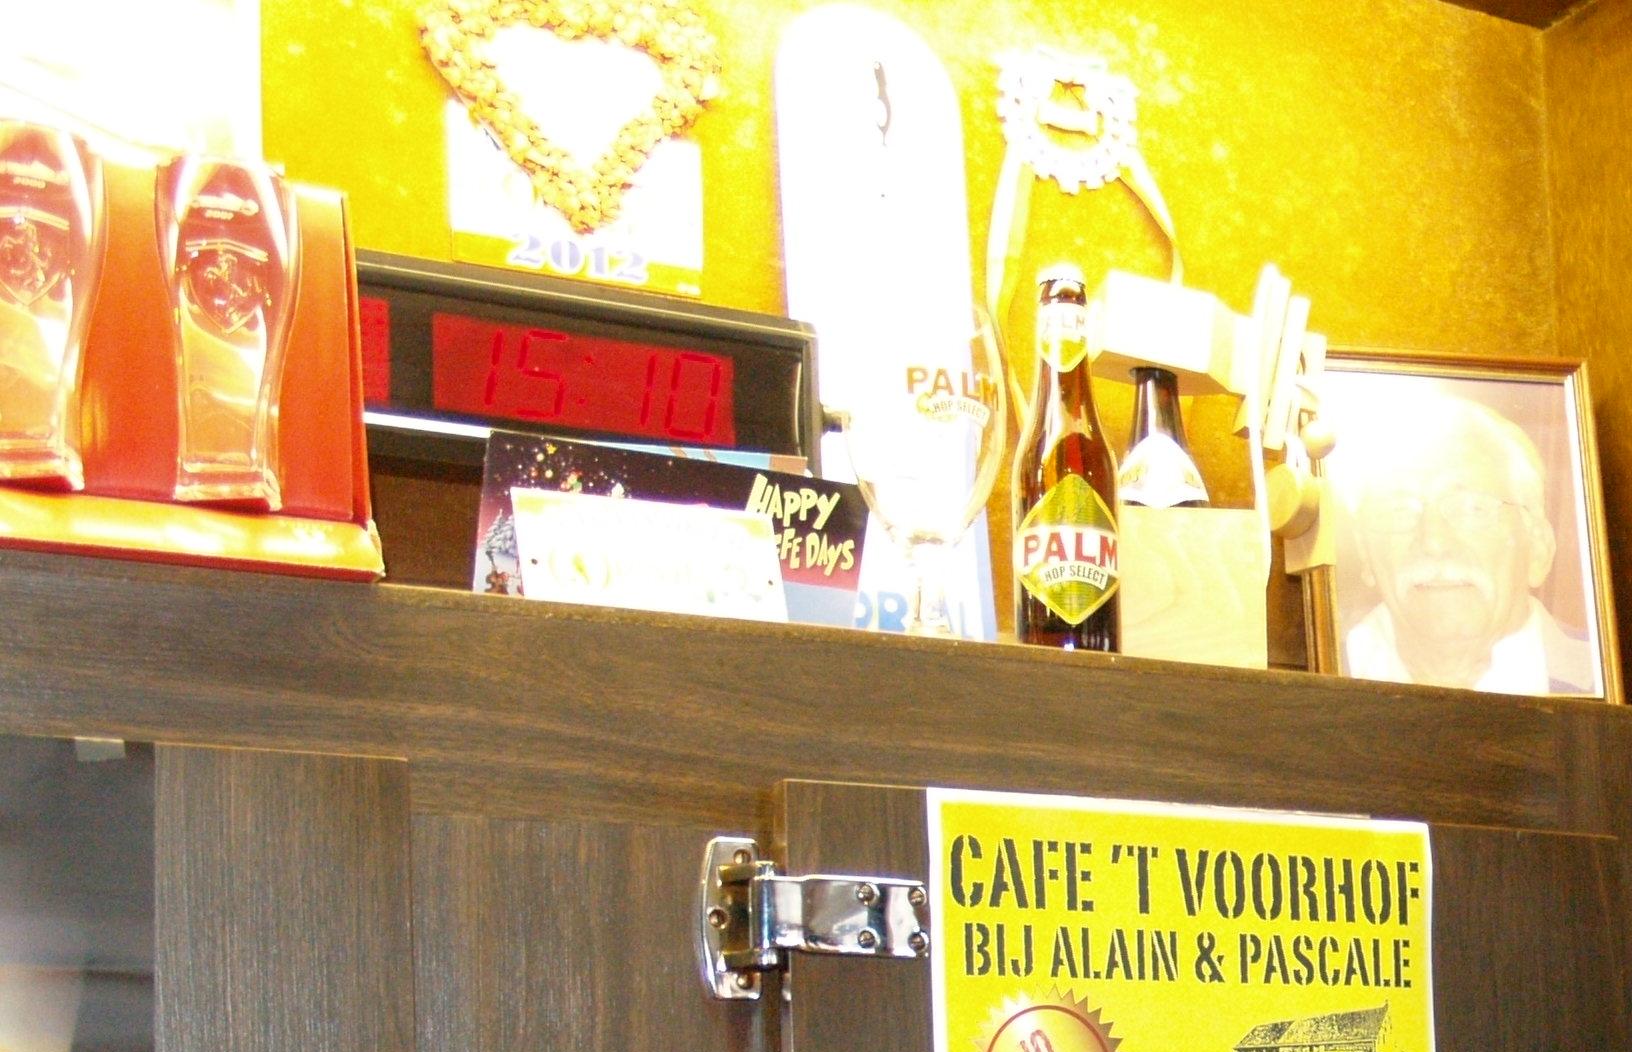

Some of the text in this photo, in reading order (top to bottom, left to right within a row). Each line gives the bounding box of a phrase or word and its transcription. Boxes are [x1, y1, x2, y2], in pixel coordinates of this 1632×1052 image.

[508, 233, 648, 283] 2012
[906, 367, 999, 411] PALM
[746, 473, 840, 530] HAPPY
[806, 532, 855, 576] DAYS
[1023, 531, 1118, 572] PALM
[1044, 565, 1106, 587] HOP SELECT
[949, 834, 1094, 911] CAFE
[1175, 847, 1420, 926] VOORHOF
[964, 921, 1412, 989] BIJ ALAIN & PASCALE
